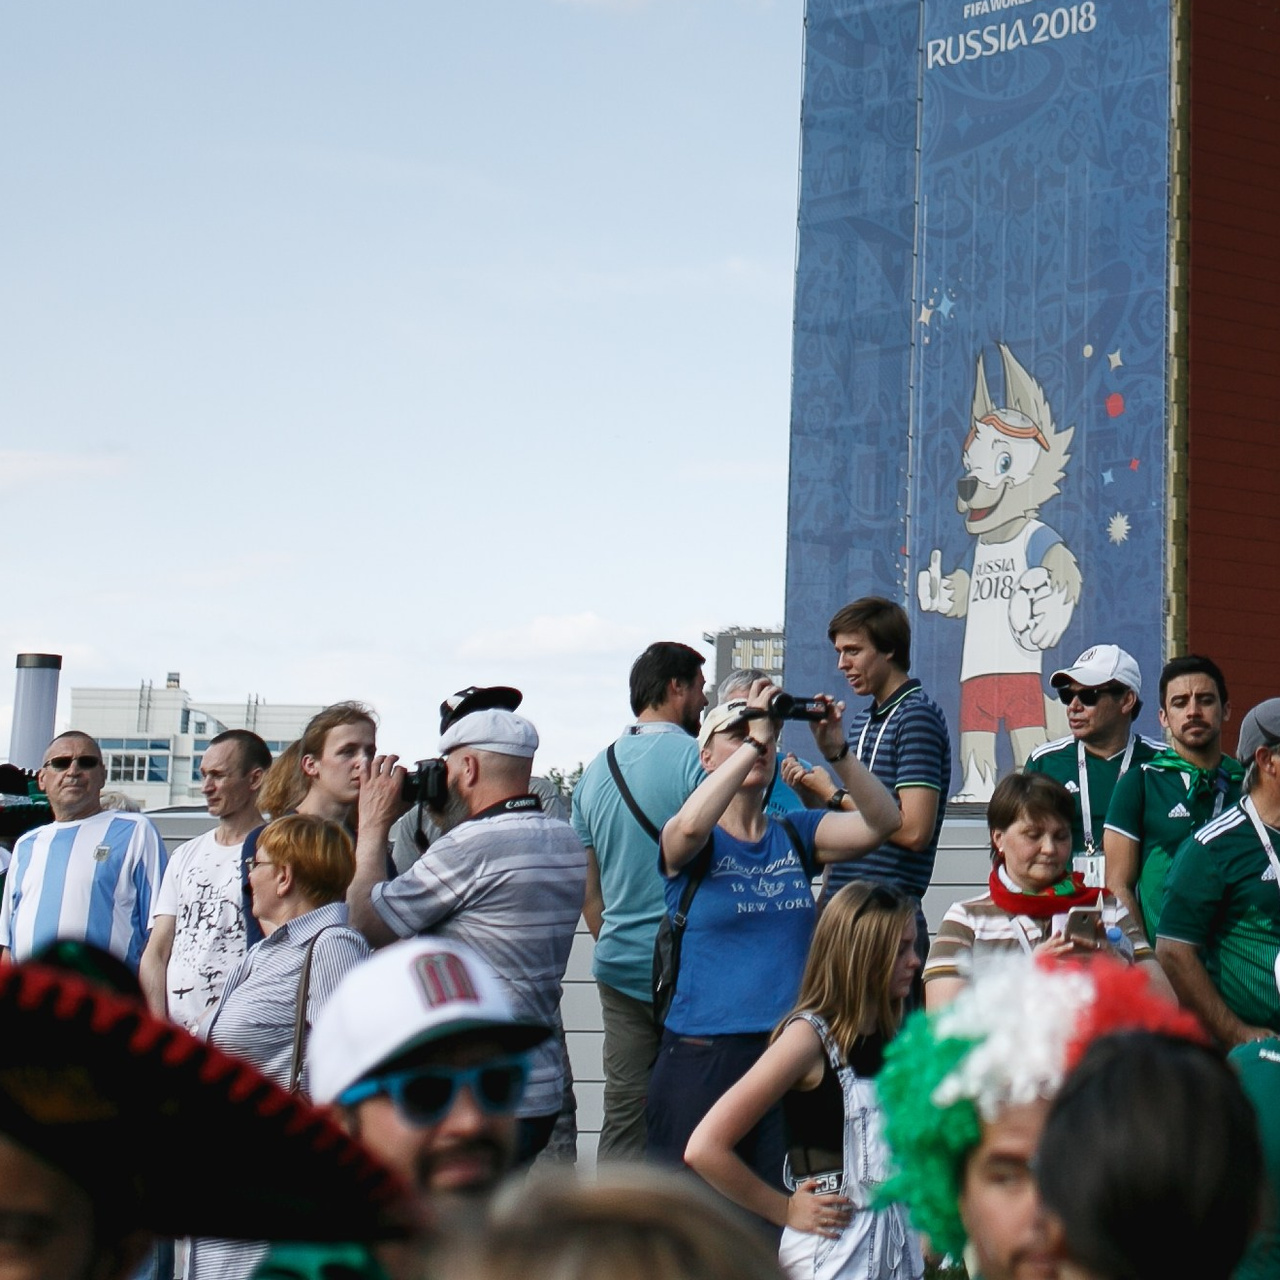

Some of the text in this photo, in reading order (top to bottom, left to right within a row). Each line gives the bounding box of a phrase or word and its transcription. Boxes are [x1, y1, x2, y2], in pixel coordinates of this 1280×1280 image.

[964, 4, 990, 19] FIFA
[927, 1, 1097, 69] RUSSIA 2018
[972, 576, 1014, 602] 2018
[737, 898, 812, 913] NEW YORK
